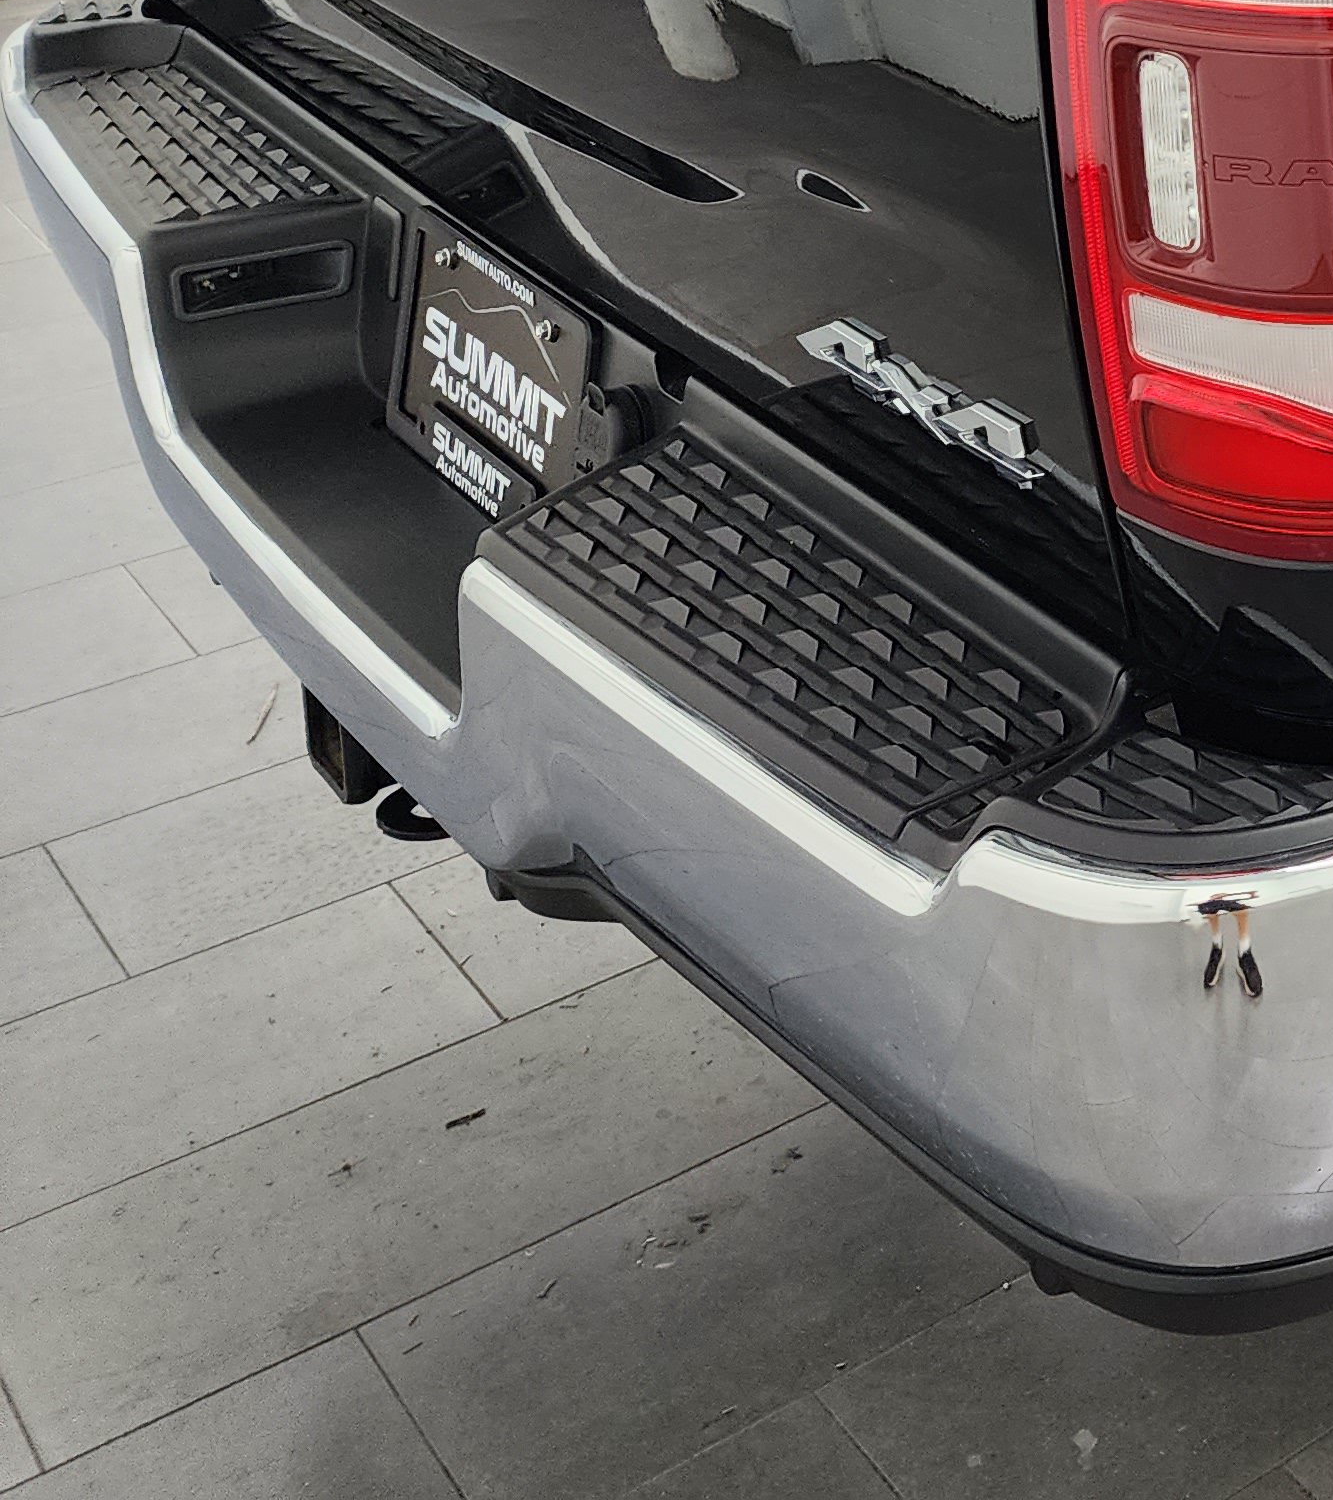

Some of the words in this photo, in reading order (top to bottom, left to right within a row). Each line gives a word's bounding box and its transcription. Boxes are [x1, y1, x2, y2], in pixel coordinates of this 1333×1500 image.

[456, 240, 535, 308] SUMMITAUTO.COM
[423, 306, 567, 445] SUMMIT
[430, 360, 546, 473] Automotive
[432, 421, 512, 502] SUMMIT
[435, 457, 499, 518] Automotive
